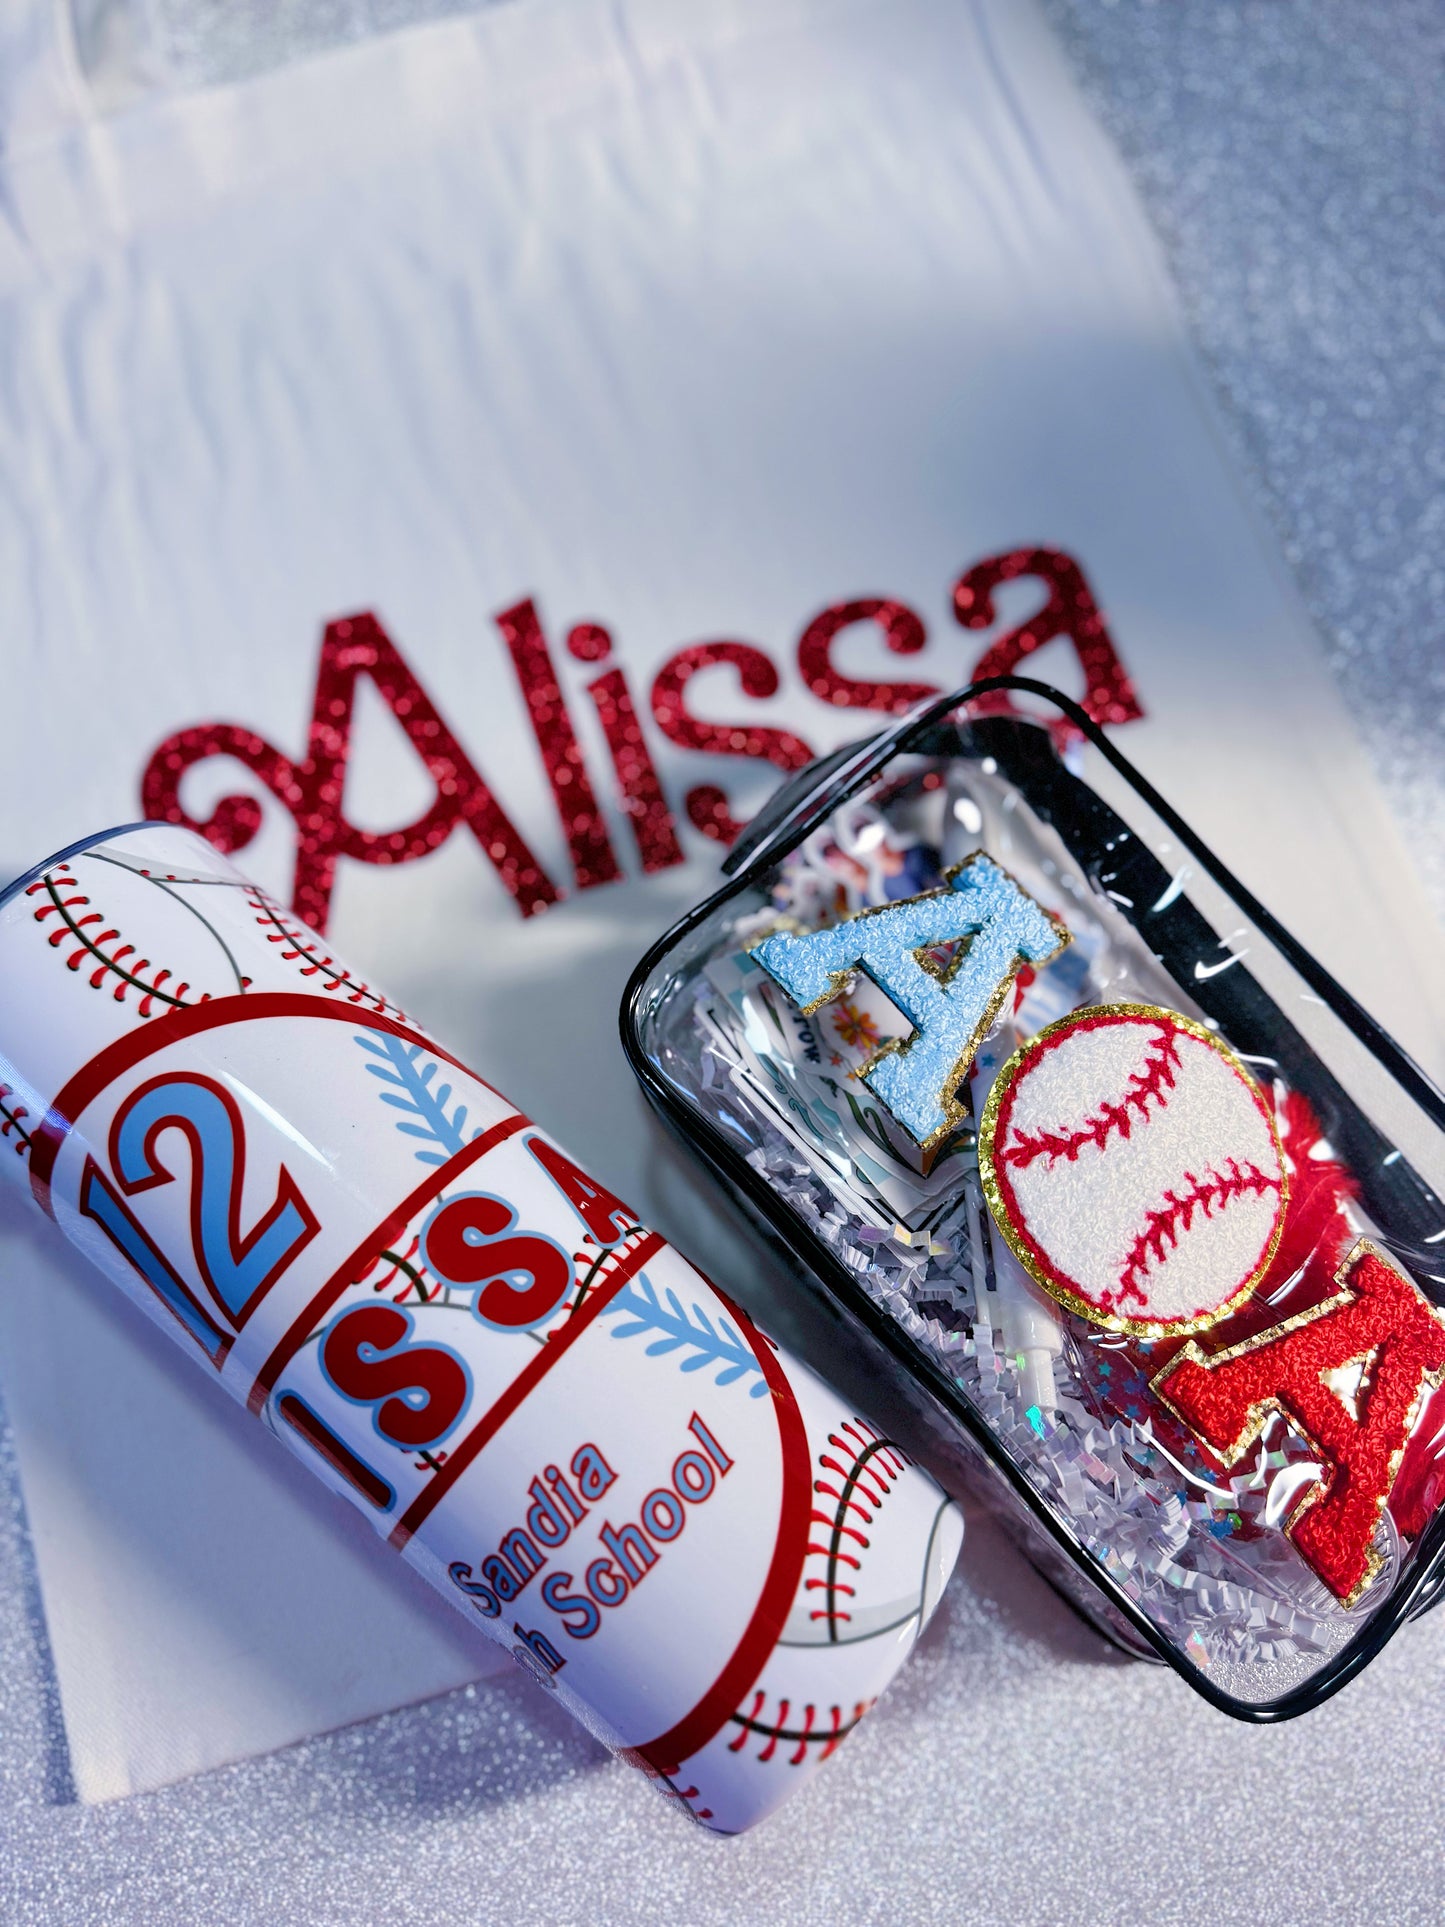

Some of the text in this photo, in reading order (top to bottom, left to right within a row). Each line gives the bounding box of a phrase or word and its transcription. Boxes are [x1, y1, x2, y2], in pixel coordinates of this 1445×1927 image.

[140, 544, 1146, 937] Alissa
[745, 850, 1075, 1149] A
[80, 1071, 321, 1372] 12
[448, 1442, 618, 1619] Sandia
[542, 1411, 735, 1640] School
[1149, 1236, 1445, 1610] A
